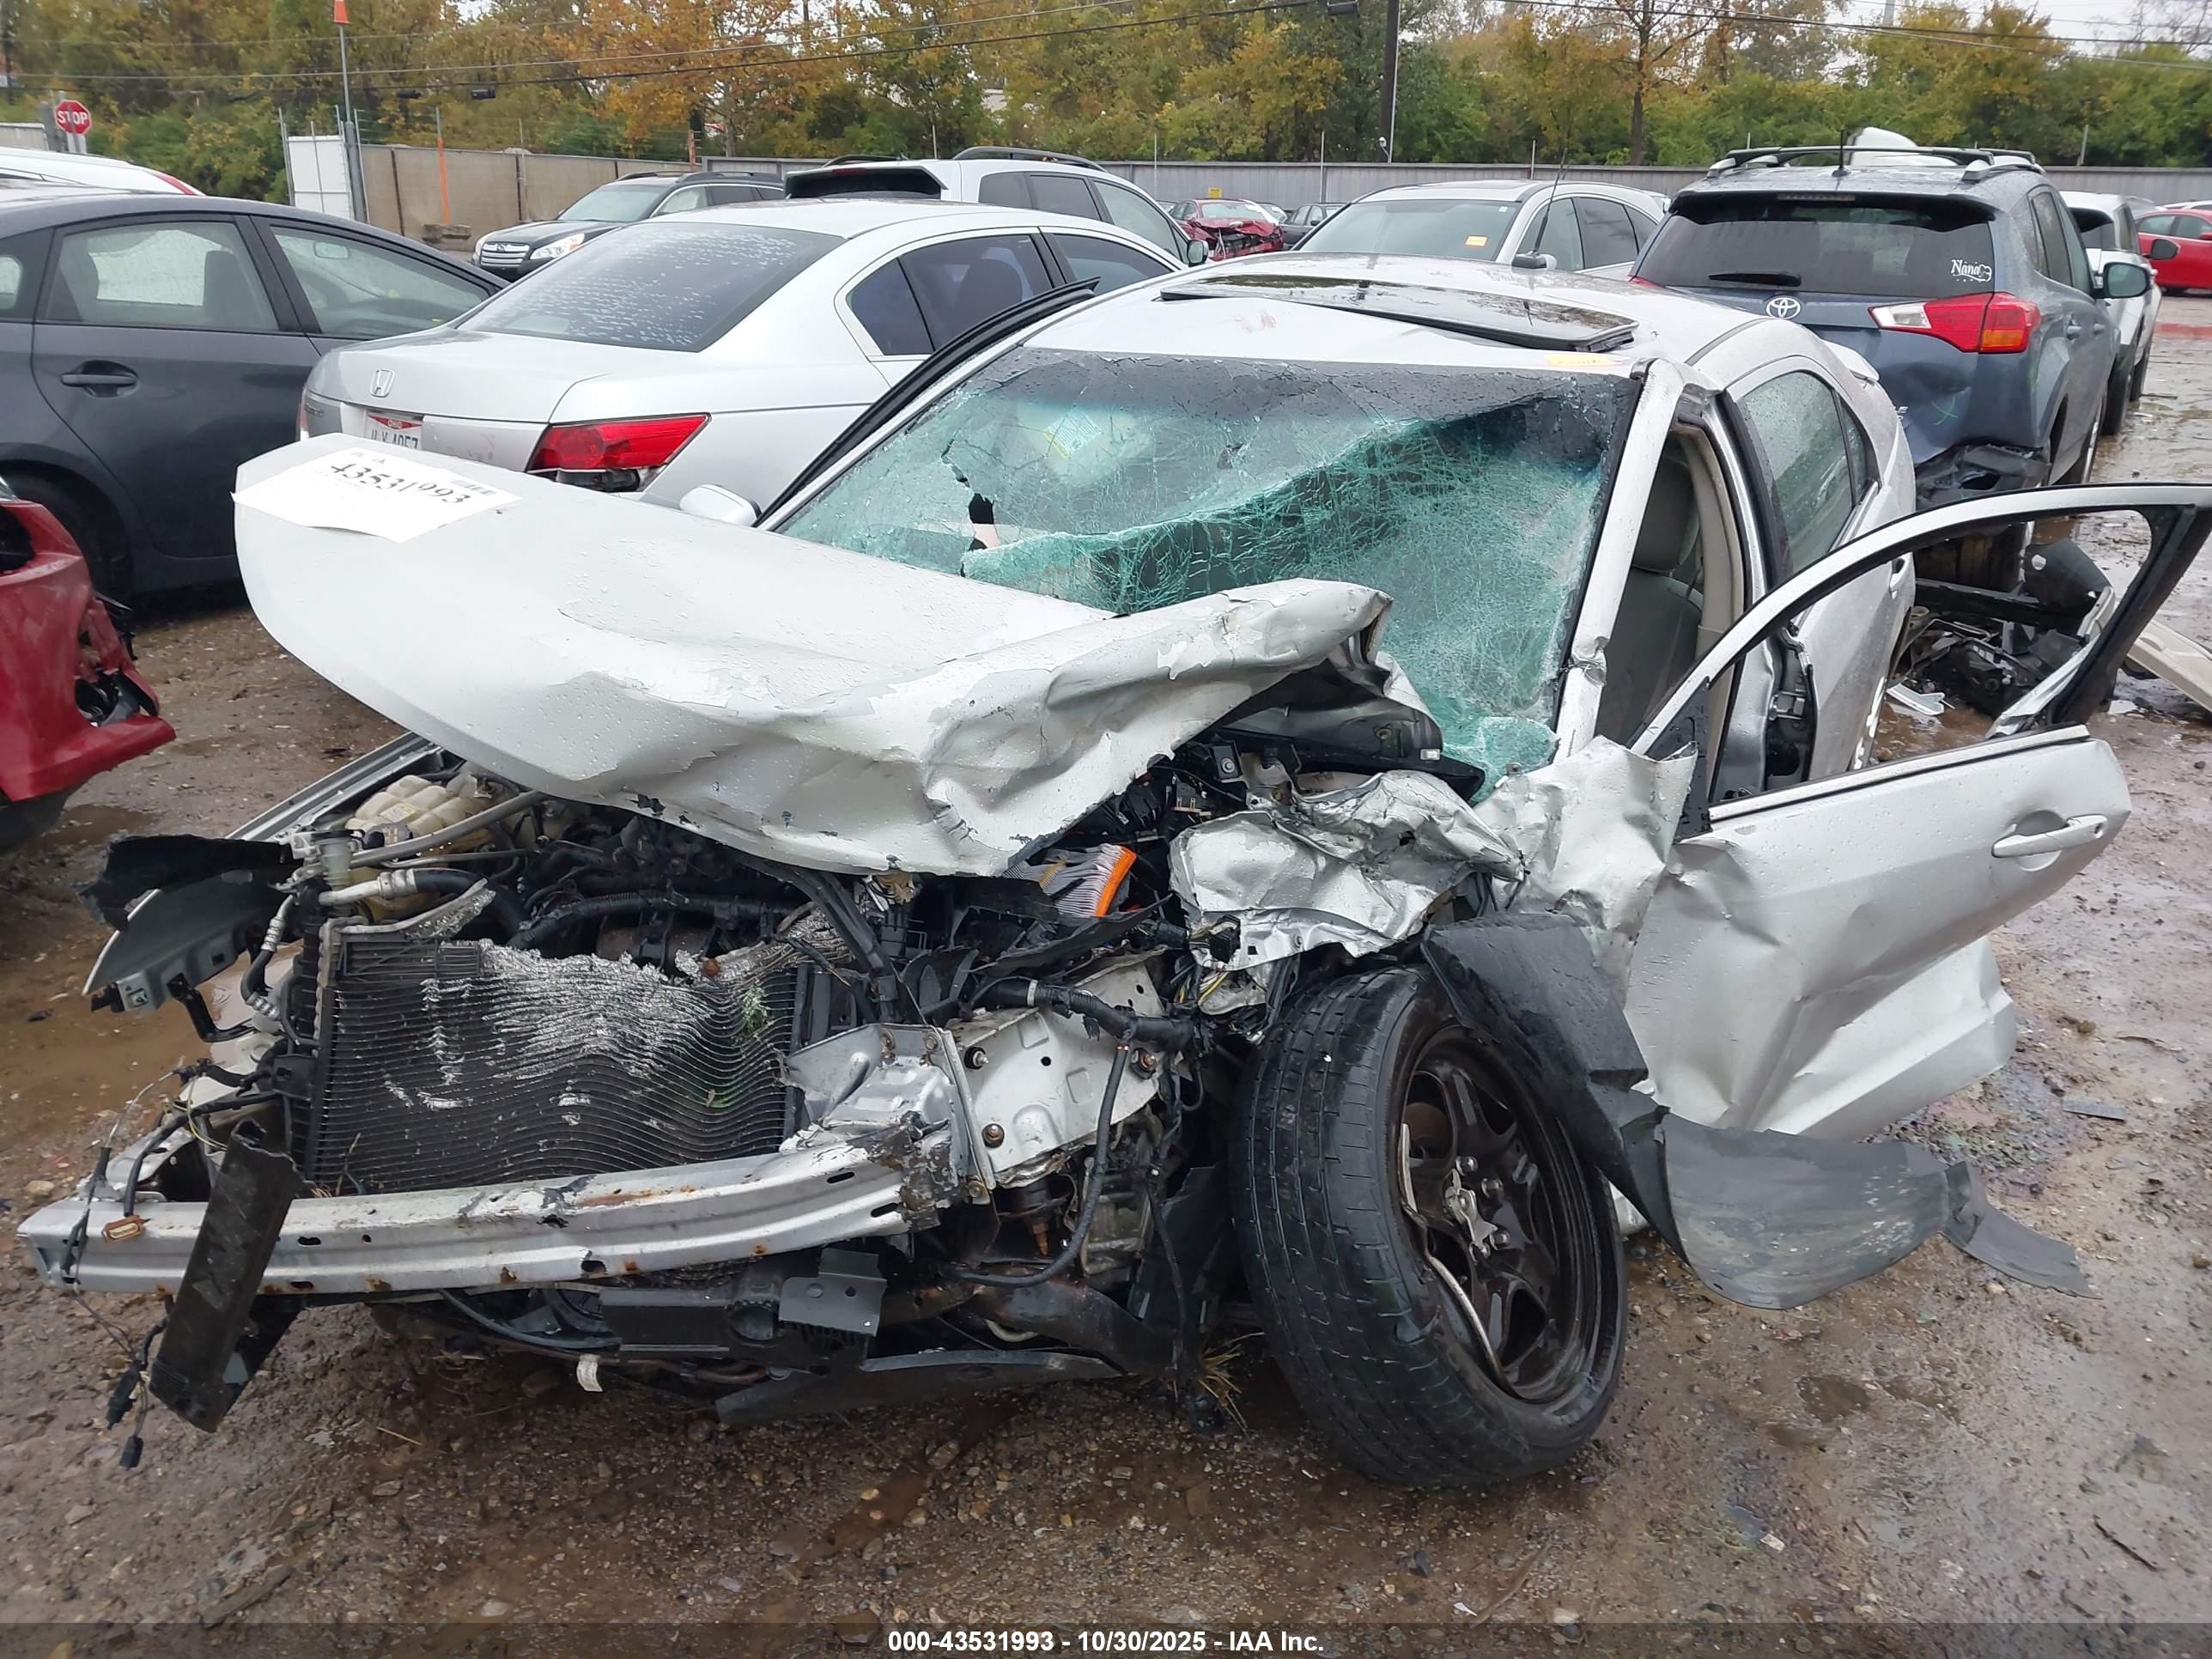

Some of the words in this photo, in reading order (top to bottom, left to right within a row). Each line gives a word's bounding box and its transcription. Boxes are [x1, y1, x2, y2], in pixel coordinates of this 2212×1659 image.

[57, 110, 88, 125] STOP
[1950, 259, 1980, 276] Nana
[331, 463, 471, 503] 43531993
